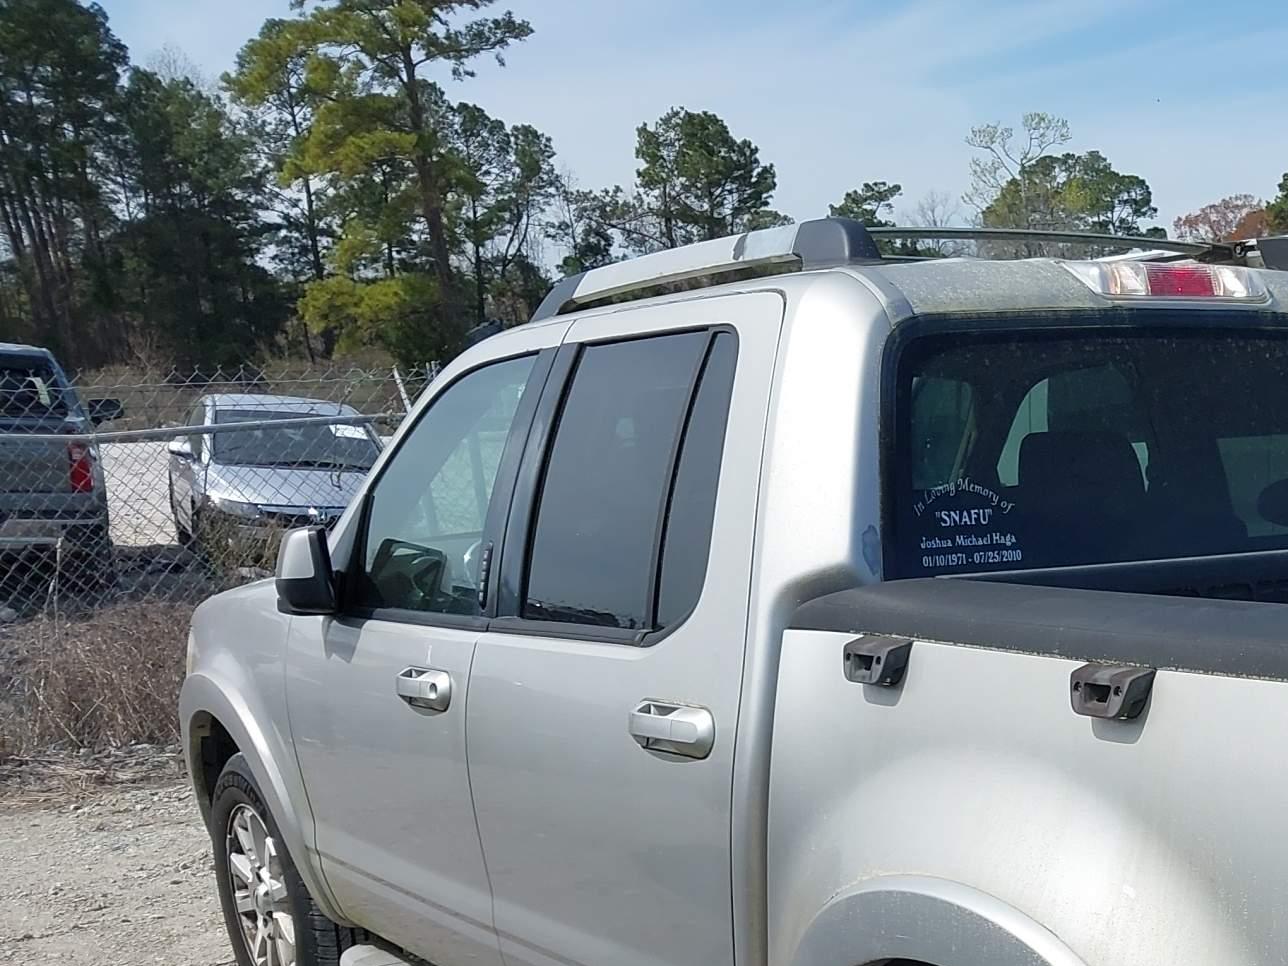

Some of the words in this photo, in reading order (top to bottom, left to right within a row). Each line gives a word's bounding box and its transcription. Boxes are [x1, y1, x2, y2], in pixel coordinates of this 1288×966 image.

[913, 501, 925, 517] In
[924, 481, 956, 504] Loving
[957, 476, 1000, 506] Memory
[1000, 500, 1016, 514] of
[935, 508, 993, 527] "SNAFU"
[920, 537, 953, 549] Joshua
[955, 533, 991, 546] Michael
[992, 532, 1016, 546] Haga
[922, 553, 967, 567] 01/10/1971
[973, 549, 1022, 564] 07/25/2010
